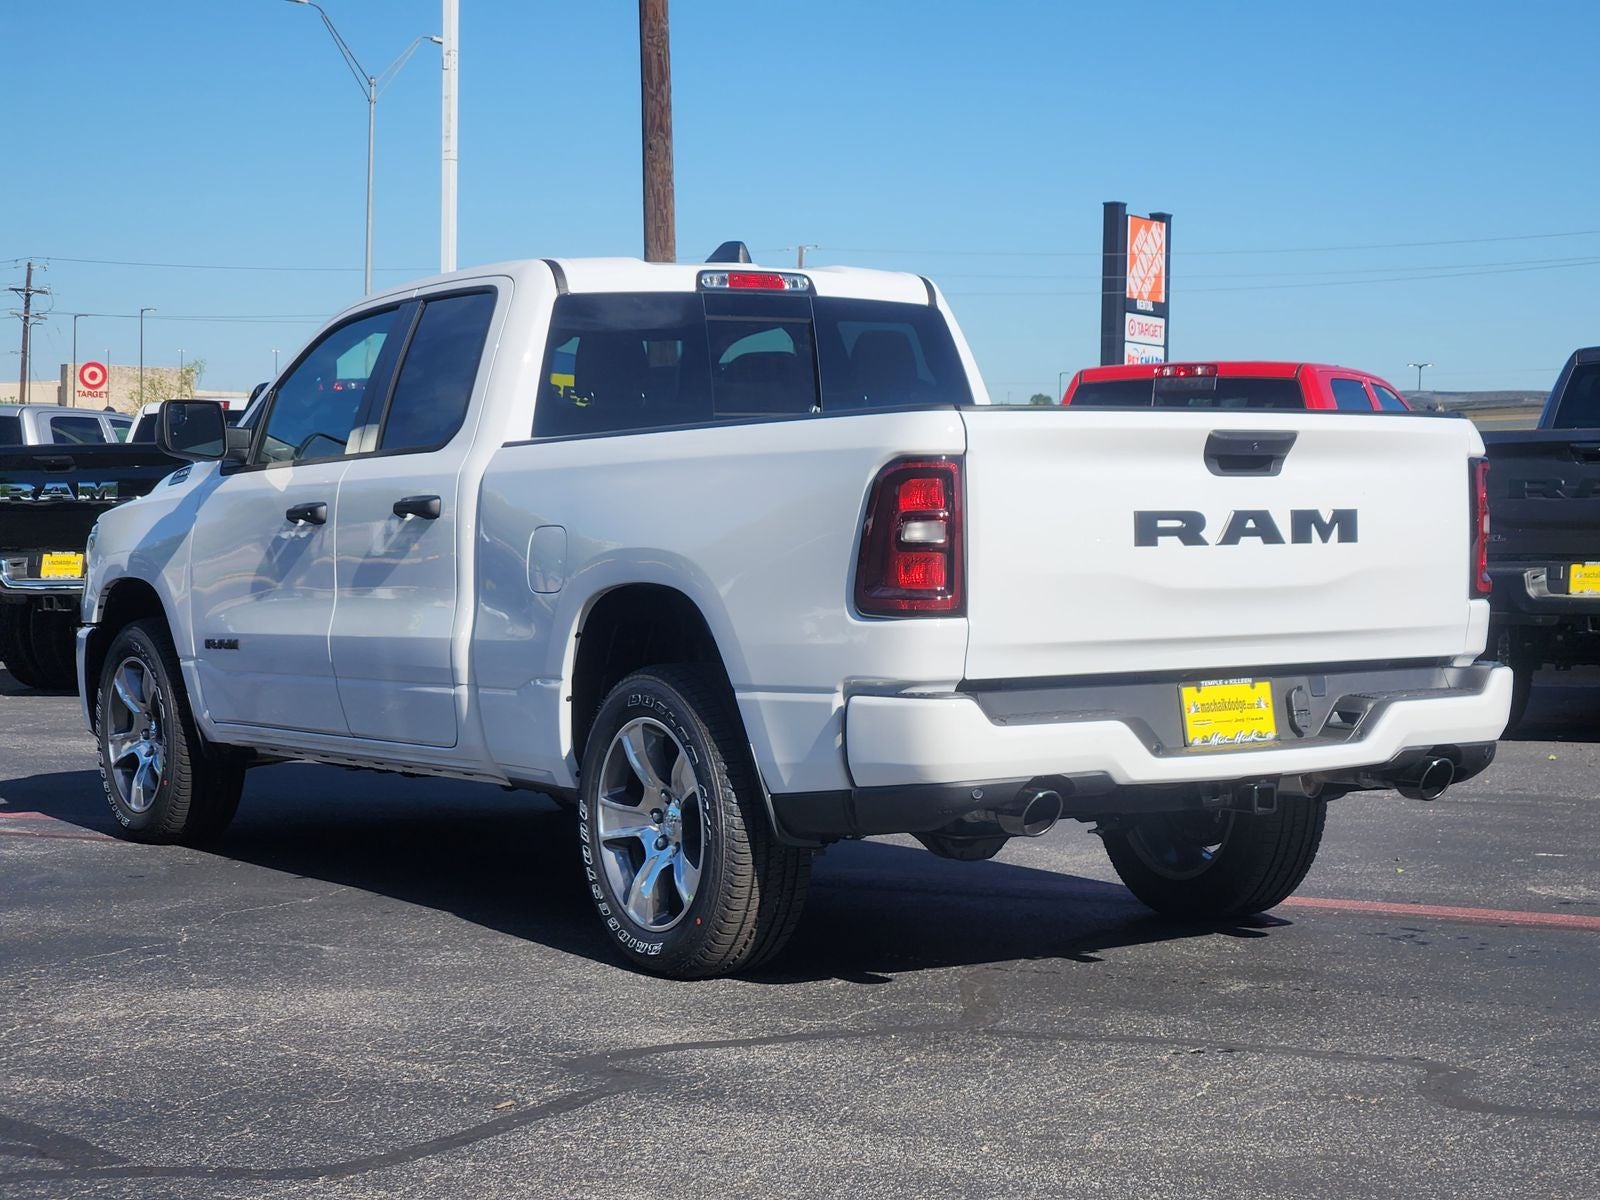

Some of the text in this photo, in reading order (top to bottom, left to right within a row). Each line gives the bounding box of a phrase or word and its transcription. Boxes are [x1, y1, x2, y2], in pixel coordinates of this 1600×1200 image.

[1137, 321, 1163, 338] TARGET
[76, 390, 109, 399] TARGET
[0, 482, 119, 501] RAM
[1133, 508, 1358, 547] RAM
[579, 799, 664, 955] BRIDGESTONE
